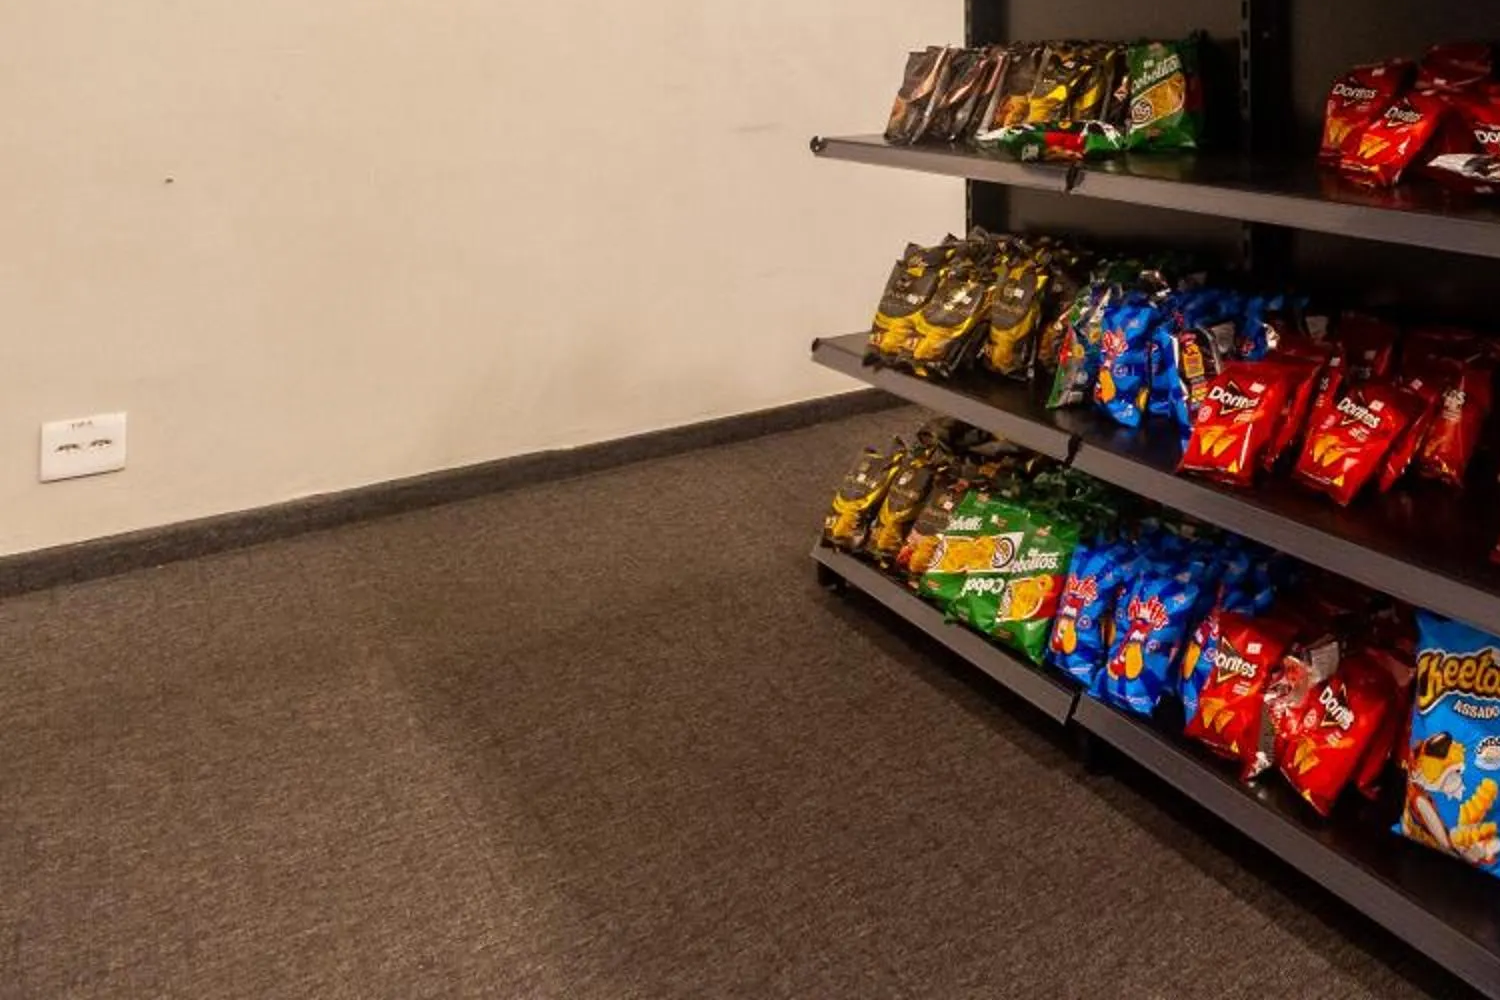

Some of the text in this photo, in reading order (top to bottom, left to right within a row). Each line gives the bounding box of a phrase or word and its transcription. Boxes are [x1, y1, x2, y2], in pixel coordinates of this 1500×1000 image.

[1332, 82, 1377, 100] Doritos
[1384, 105, 1425, 123] Doritos
[1337, 396, 1382, 429] Doritos
[1453, 699, 1500, 719] ASSADO
